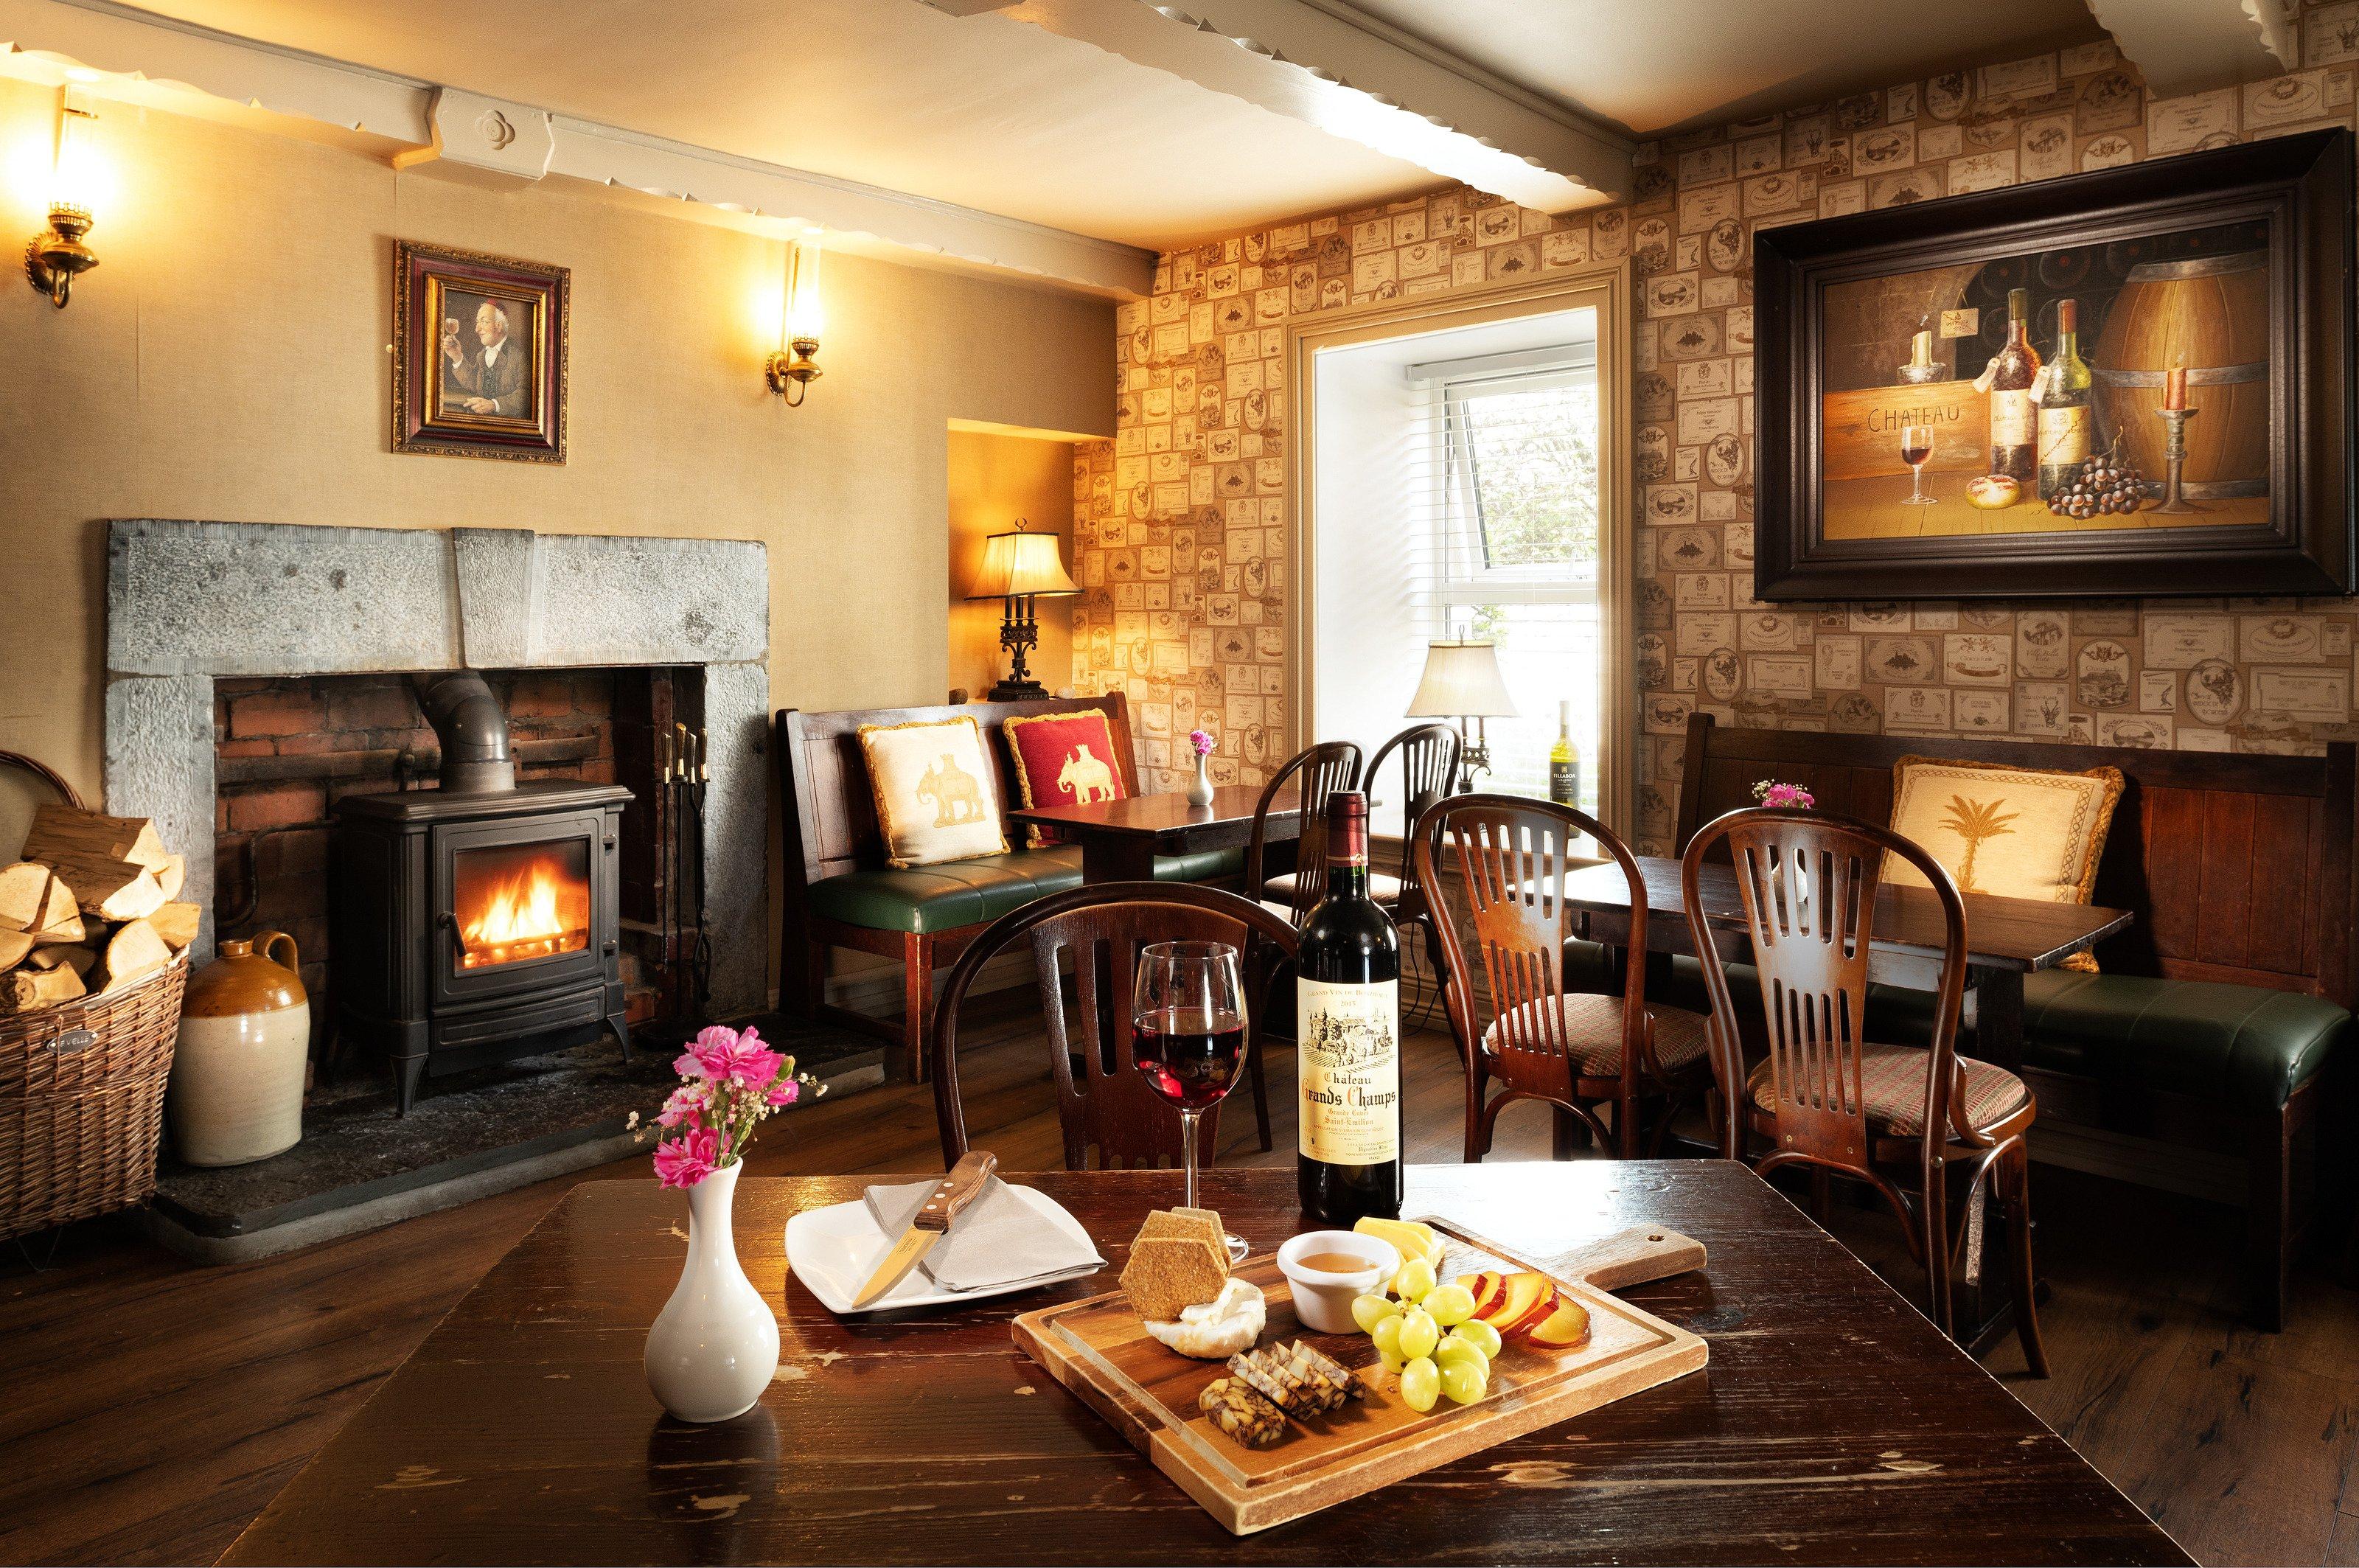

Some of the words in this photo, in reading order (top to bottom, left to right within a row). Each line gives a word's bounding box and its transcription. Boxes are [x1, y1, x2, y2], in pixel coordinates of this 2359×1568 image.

[1867, 406, 1960, 433] CHATEAU
[1302, 1077, 1342, 1107] Grands
[1347, 1085, 1396, 1111] Champs
